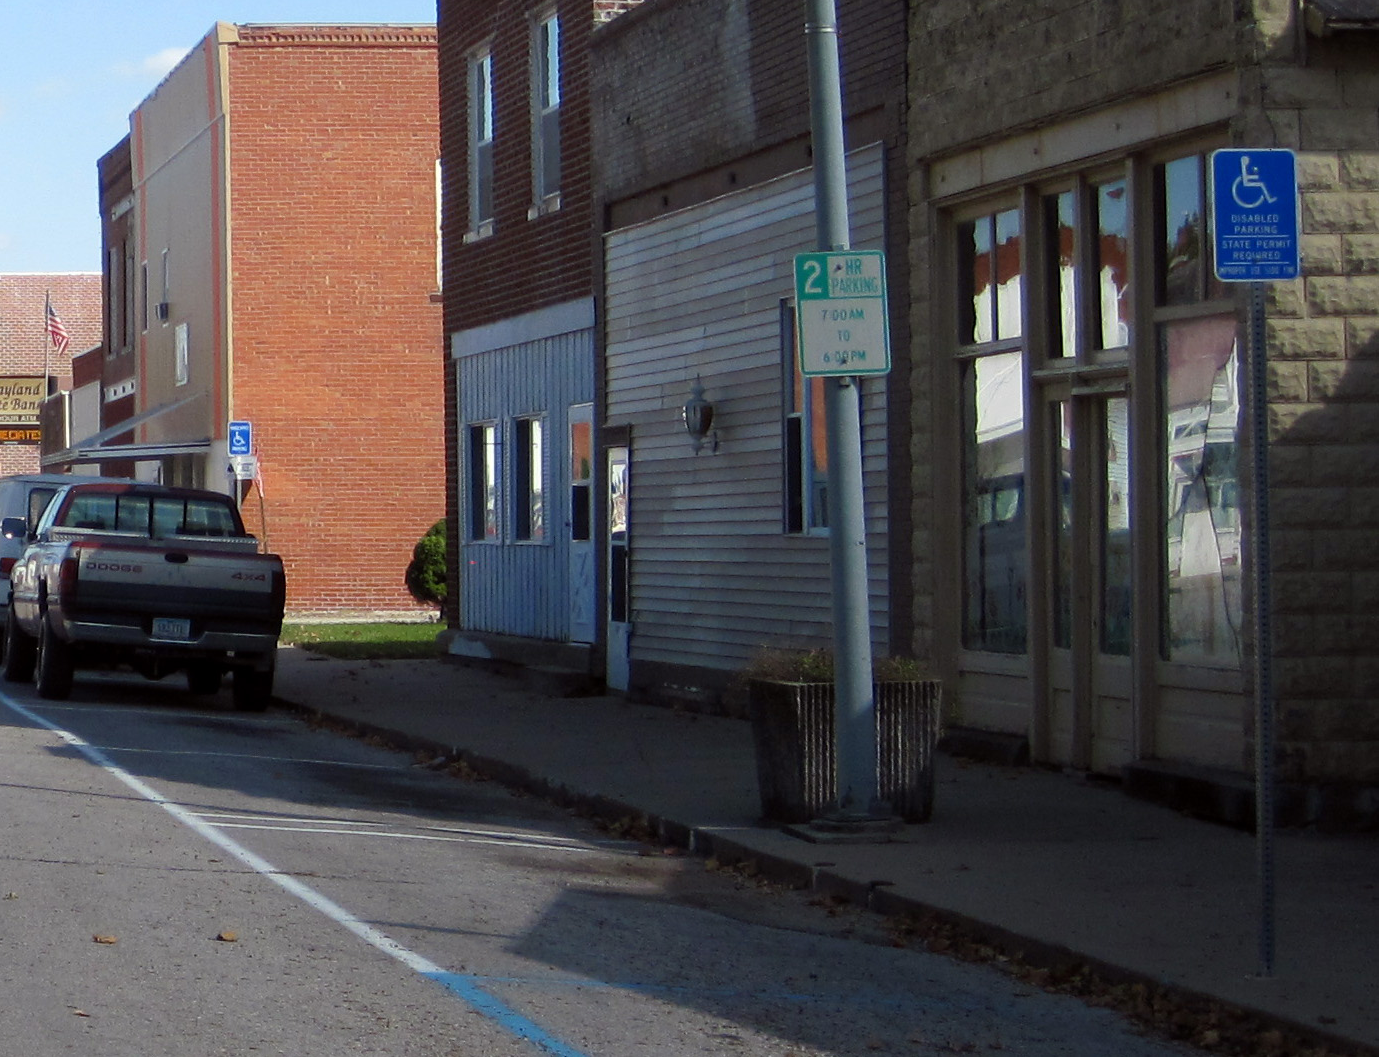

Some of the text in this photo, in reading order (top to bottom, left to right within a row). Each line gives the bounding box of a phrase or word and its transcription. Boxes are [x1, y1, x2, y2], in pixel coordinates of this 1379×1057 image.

[1231, 214, 1279, 223] DISABLED
[1234, 225, 1278, 234] PARKING
[1222, 239, 1291, 249] STATE PERMIT
[1232, 251, 1281, 260] REQUIRED
[845, 259, 862, 275] HR
[803, 260, 822, 293] 2
[832, 277, 879, 293] PARKING
[837, 329, 850, 342] TO
[85, 561, 144, 573] DODGE
